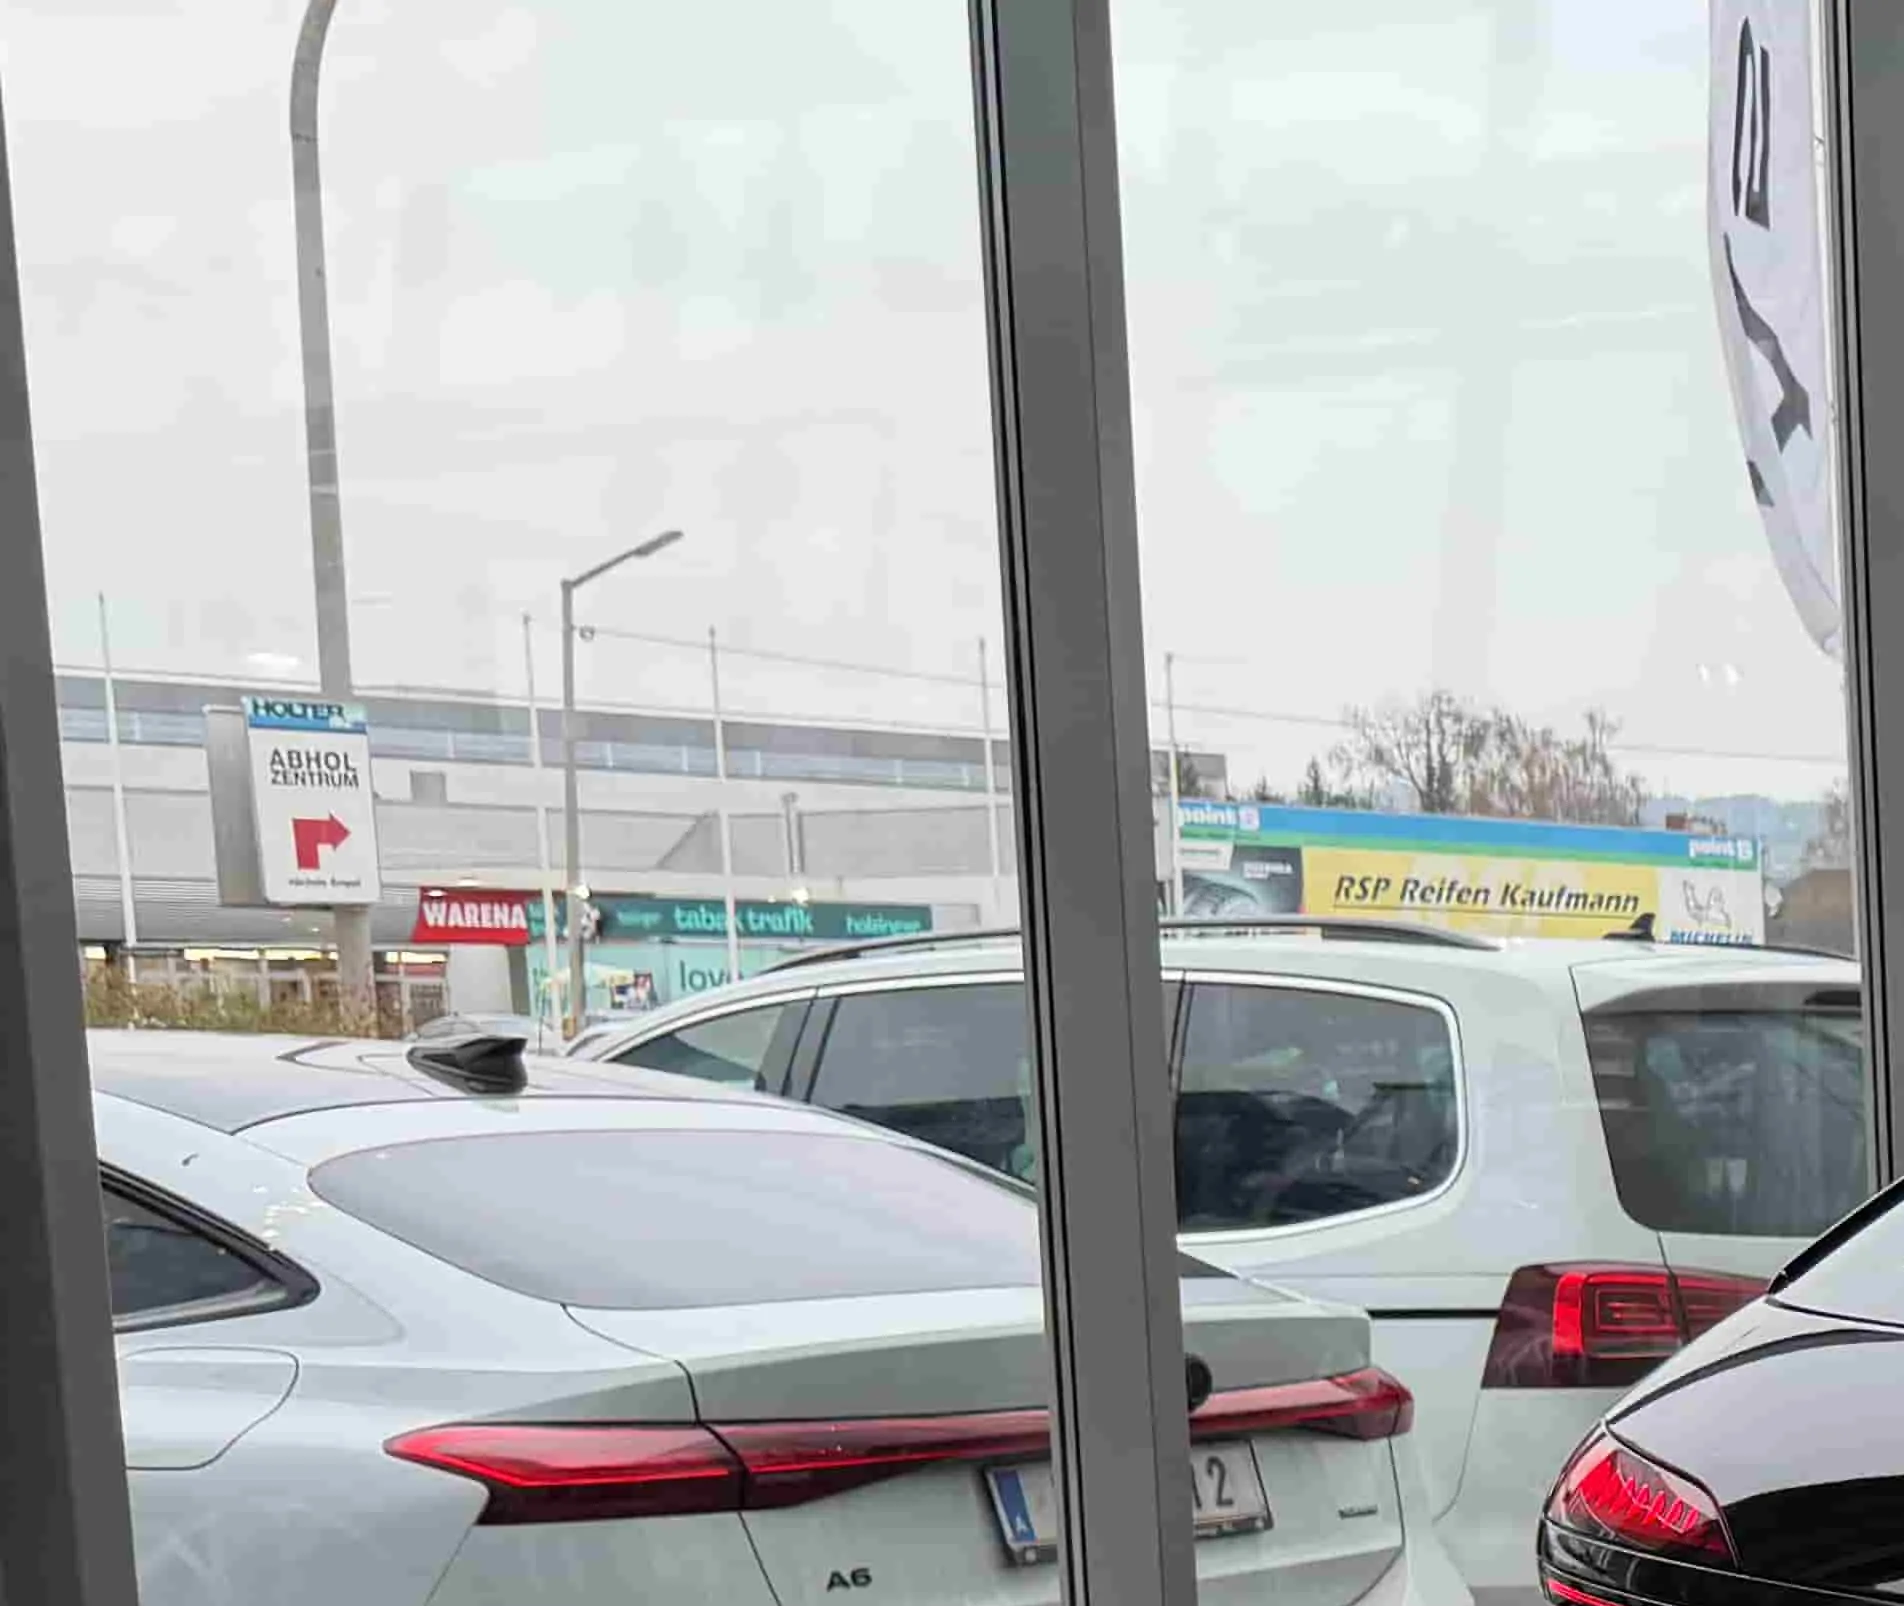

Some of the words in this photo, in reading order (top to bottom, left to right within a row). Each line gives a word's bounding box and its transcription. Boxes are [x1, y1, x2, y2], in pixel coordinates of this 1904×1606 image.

[252, 699, 345, 720] HOLTER
[269, 748, 356, 772] ABHOL
[271, 769, 360, 788] ZENTRUM
[1335, 875, 1390, 900] RSP
[1400, 877, 1490, 906] Reifen
[1500, 881, 1640, 912] Kaufmann
[423, 901, 527, 928] WARENA
[826, 1568, 873, 1592] A6
